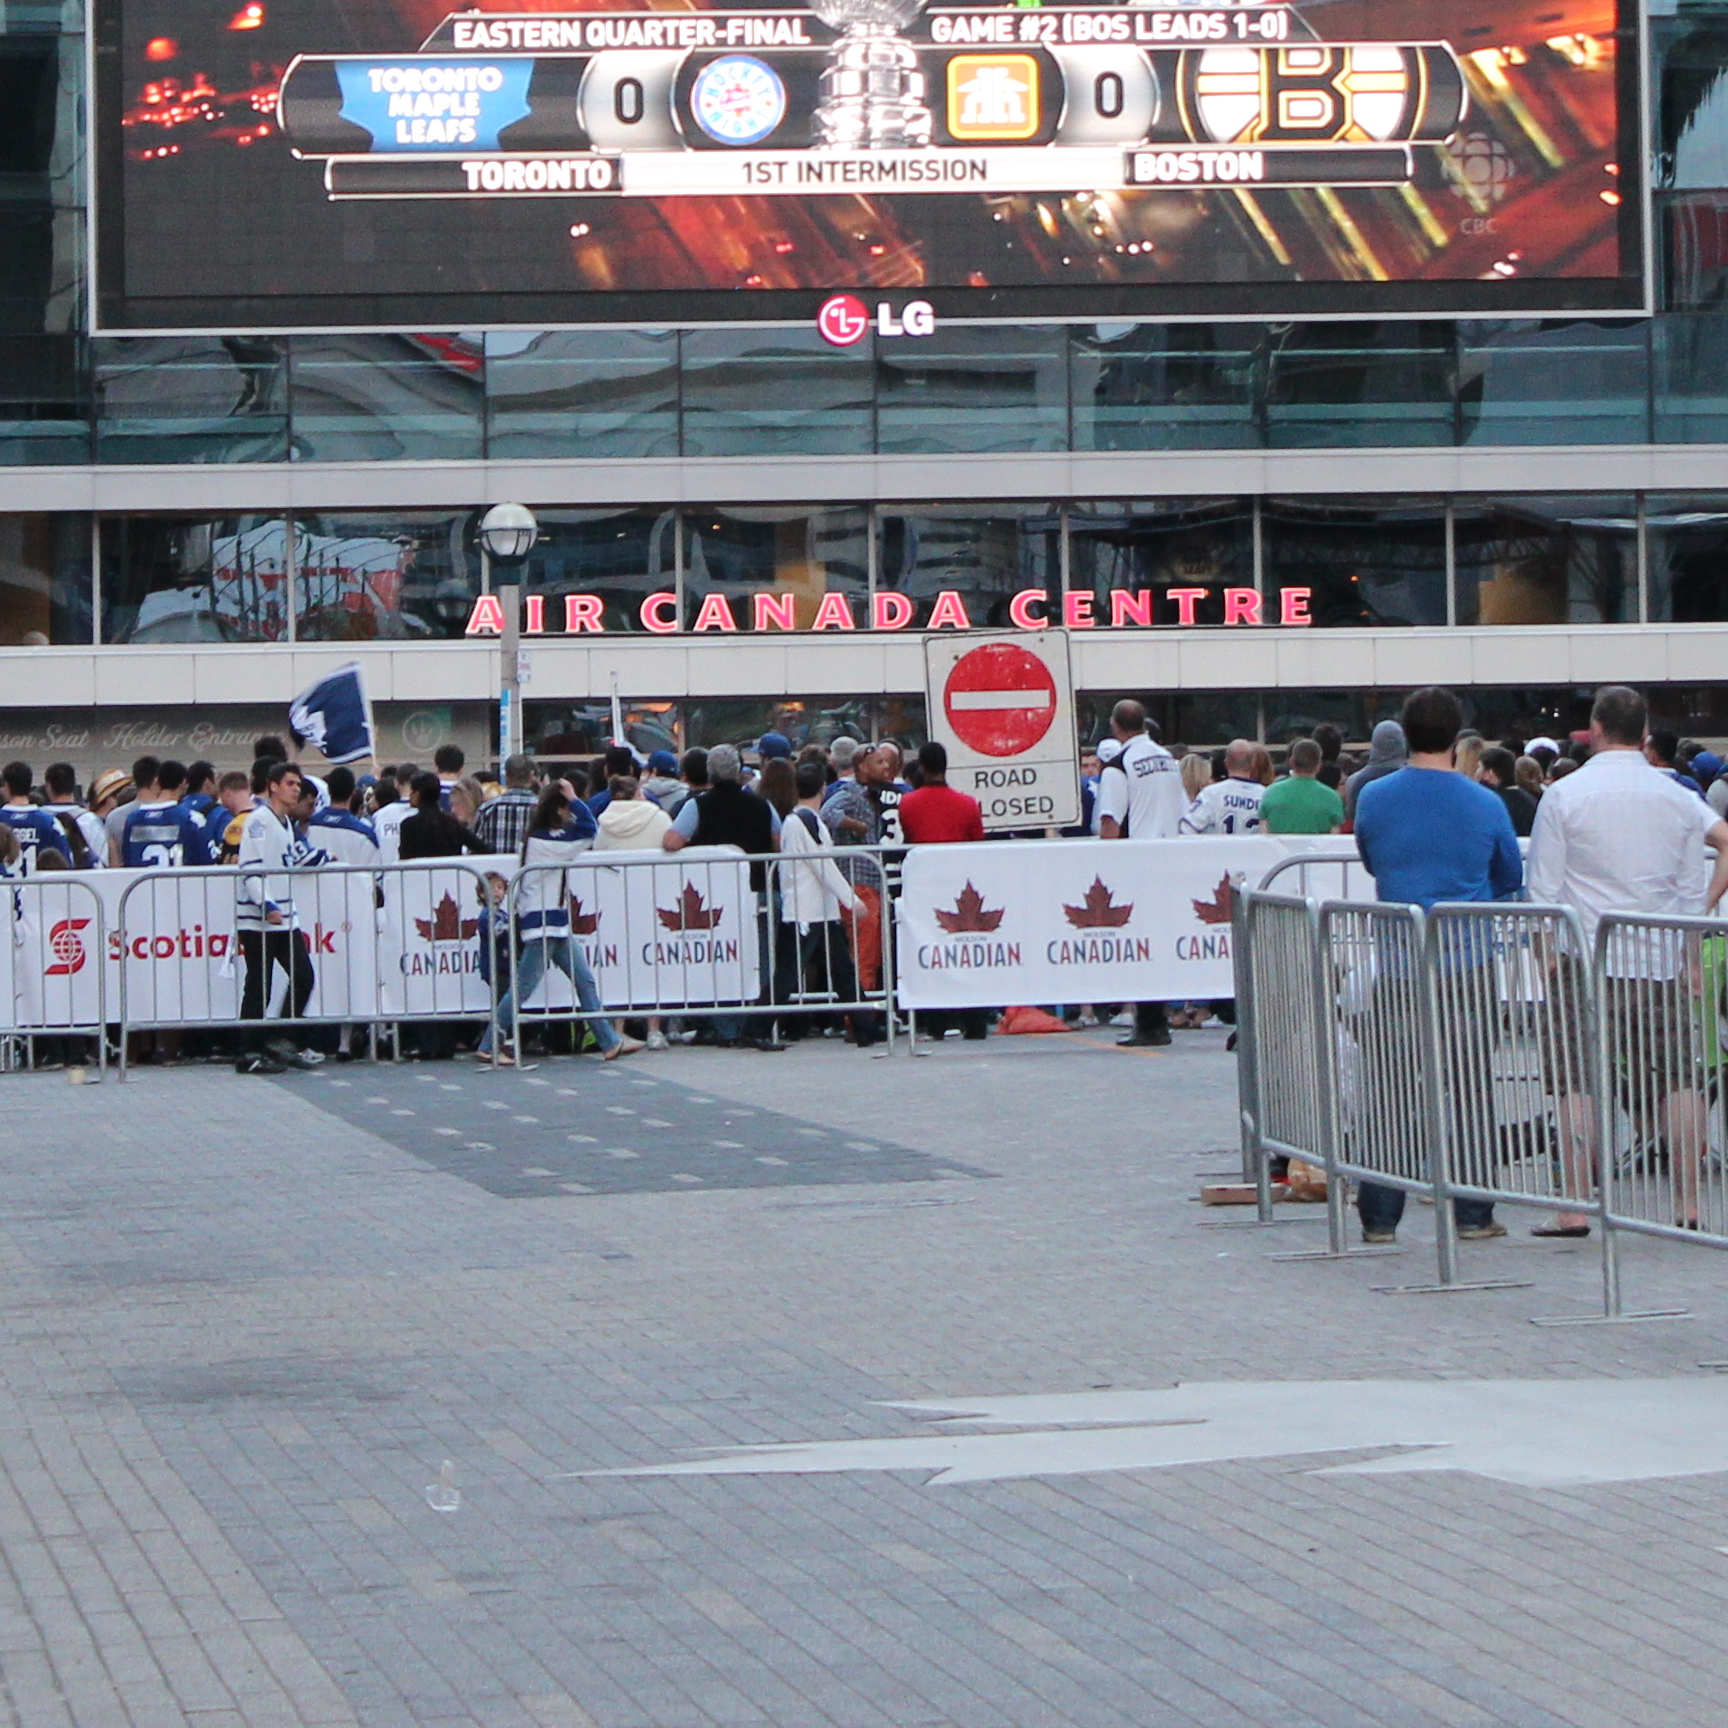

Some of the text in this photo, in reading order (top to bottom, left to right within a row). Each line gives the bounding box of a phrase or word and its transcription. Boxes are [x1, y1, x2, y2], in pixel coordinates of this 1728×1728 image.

[453, 18, 812, 49] EASTERN QUARTER-FINAL
[931, 9, 1288, 43] GAME #2 (BOS LEADS 1-0)
[367, 66, 503, 92] TORONTO
[387, 92, 481, 118] MAPLE
[613, 77, 645, 125] 0
[1094, 71, 1123, 119] 0
[395, 118, 476, 144] LEAFS
[460, 159, 613, 191] TORONTO
[742, 158, 988, 184] 1ST INTERMISSION
[1133, 152, 1264, 182] BOSTON
[1460, 217, 1499, 234] CBC
[877, 300, 936, 338] LG
[465, 586, 1314, 634] AIR CANADA CENTRE
[37, 723, 90, 751] Seat
[103, 720, 184, 750] Holder
[974, 767, 1038, 789] ROAD
[978, 794, 1055, 819] LOSED
[641, 939, 739, 966] CANADIAN
[917, 942, 1021, 970] CANADIAN
[1046, 936, 1150, 966] CANADIAN
